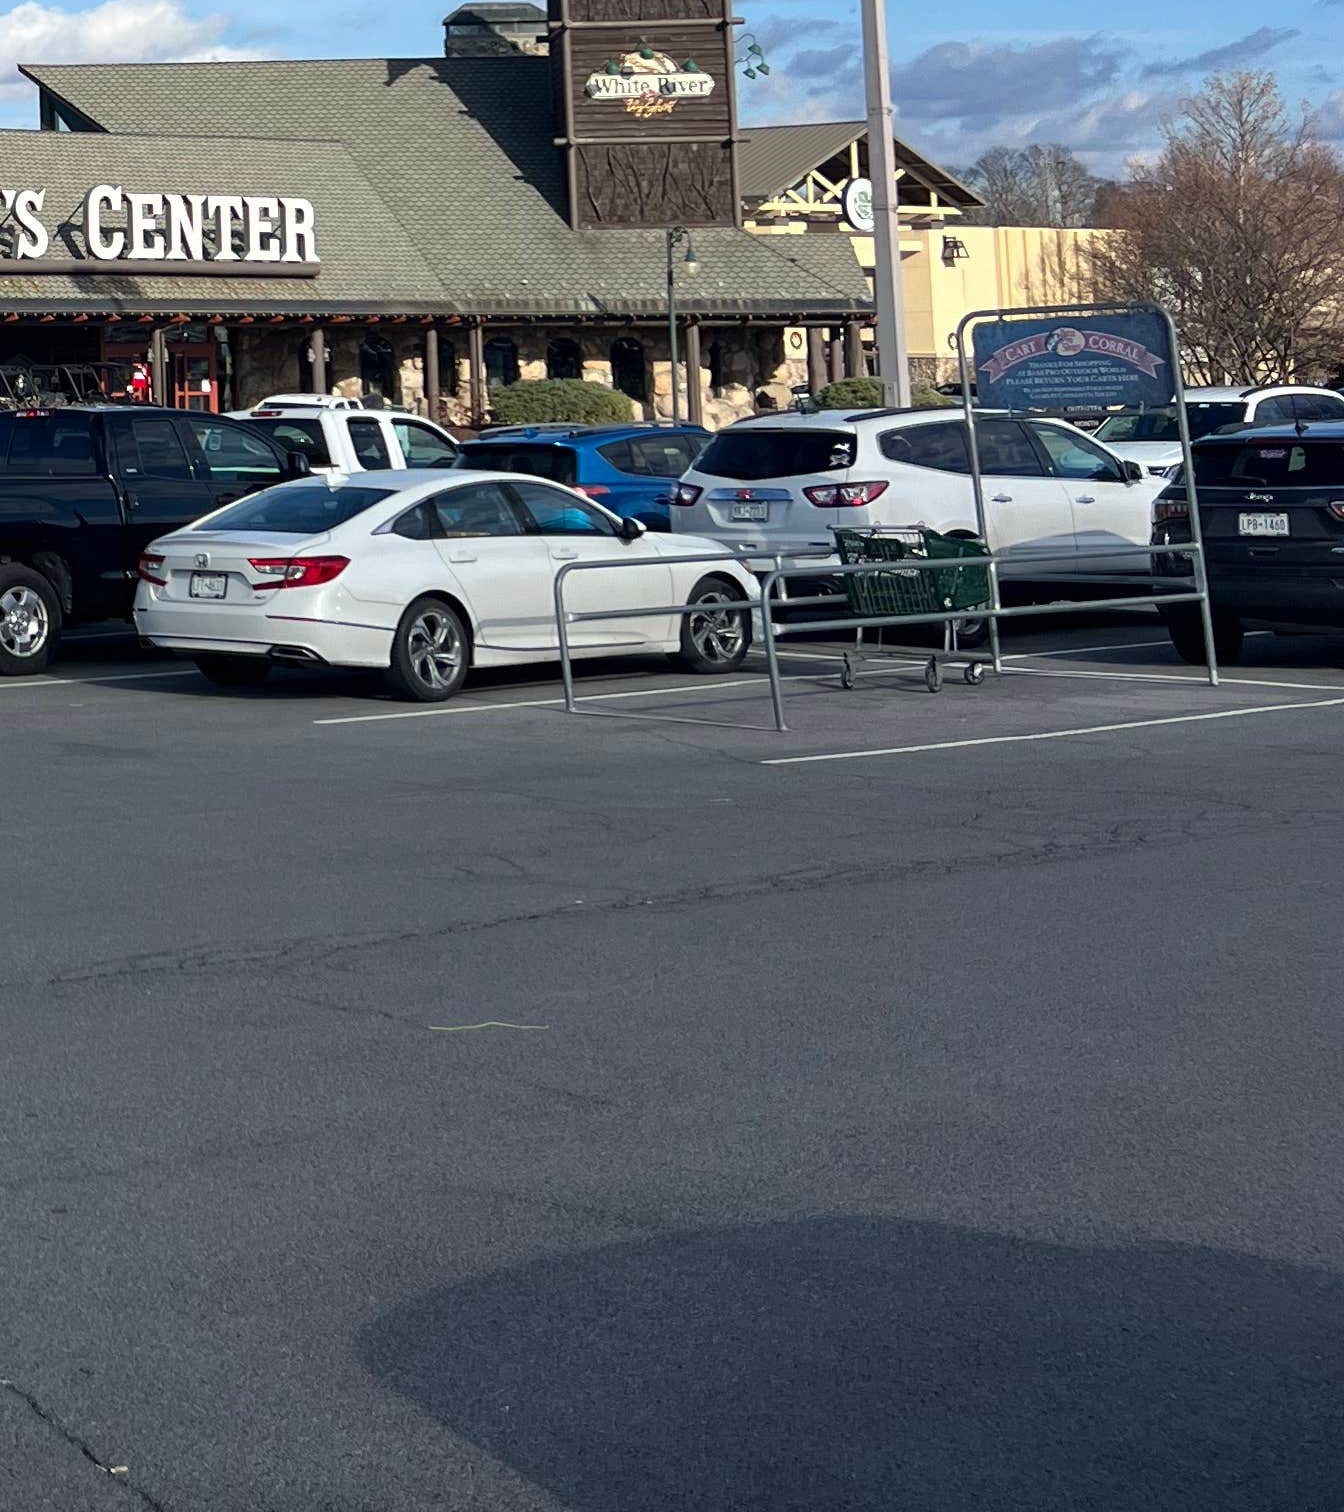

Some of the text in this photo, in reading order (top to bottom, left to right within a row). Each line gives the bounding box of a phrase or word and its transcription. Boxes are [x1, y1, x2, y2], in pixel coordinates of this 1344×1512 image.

[594, 76, 708, 95] White River
[87, 184, 320, 262] CENTER
[1005, 341, 1036, 361] CART
[1088, 335, 1140, 360] CORRAL
